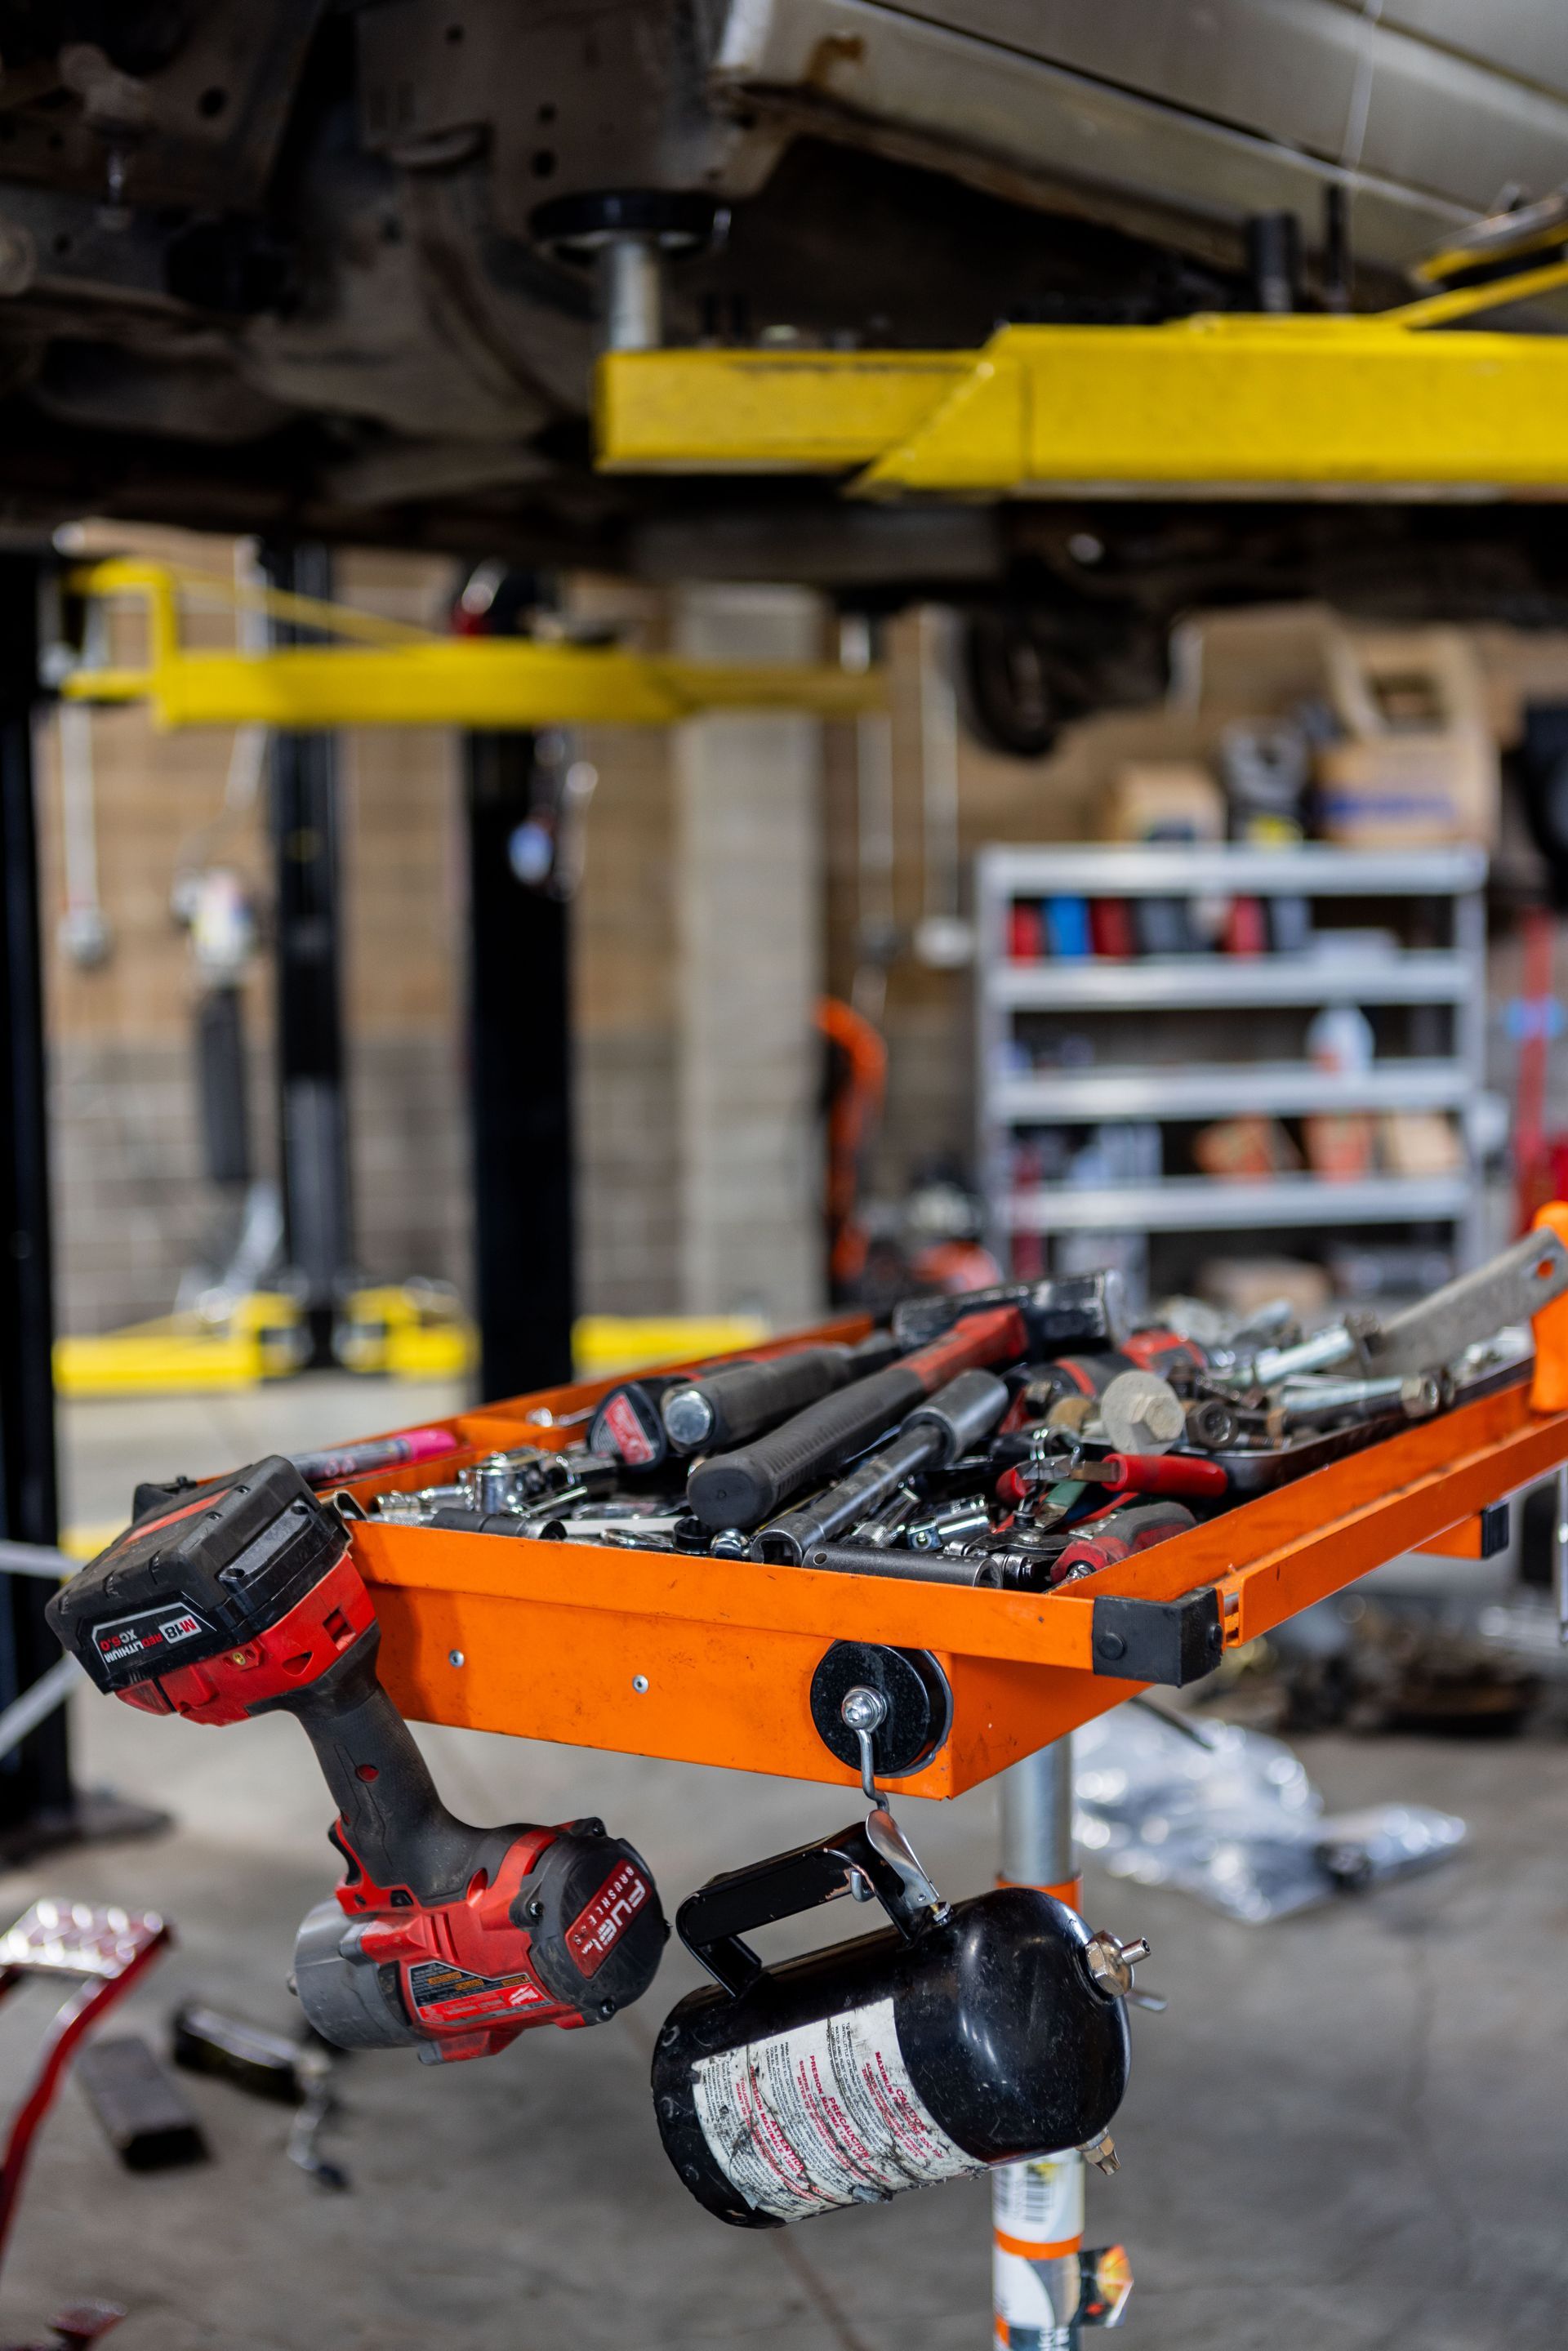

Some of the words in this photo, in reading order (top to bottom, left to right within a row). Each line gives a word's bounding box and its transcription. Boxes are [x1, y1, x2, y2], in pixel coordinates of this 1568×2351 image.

[103, 1632, 163, 1663] REDLITHIUM
[164, 1619, 197, 1640] M18
[581, 1878, 646, 1954] FUEL
[798, 2059, 810, 2091] SIEMPRE
[845, 2059, 851, 2068] OR
[846, 2021, 849, 2029] TO
[855, 2073, 863, 2090] HOLD
[722, 2074, 726, 2082] LA
[735, 2082, 743, 2104] AVANT
[741, 2106, 747, 2116] DE
[739, 2077, 752, 2114] TOUJOURS
[773, 2045, 777, 2053] EN
[776, 2067, 789, 2105] PULVERIZADOR
[786, 2105, 792, 2113] NO
[843, 2073, 855, 2098] CAUSING
[749, 2064, 763, 2110] PRESSION
[760, 2112, 783, 2153] MAXIMALE
[782, 2155, 798, 2172] 1380
[773, 2097, 783, 2115] MAYOR
[775, 2086, 790, 2118] SOLUCIONES
[785, 2077, 794, 2101] GATILLO
[791, 2100, 801, 2118] HASTA
[799, 2118, 807, 2130] QUE
[814, 2145, 826, 2159] POCO
[796, 2076, 807, 2099] ANTES
[804, 2100, 811, 2110] DE
[808, 2111, 826, 2138] RETIRAR
[809, 2055, 823, 2095] PRESION
[820, 2095, 840, 2128] MAXIMA
[838, 2131, 853, 2148] 1380
[845, 2095, 858, 2116] SHOULD
[857, 2116, 865, 2126] NOT
[861, 2068, 875, 2095] BEFORE
[873, 2097, 895, 2130] REMOVING
[893, 2131, 904, 2140] ANY
[902, 2141, 920, 2157] PARTS
[865, 2062, 878, 2089] ALWAYS
[875, 2091, 906, 2135] DEPRESSURIZE
[905, 2136, 928, 2157] SPRAYER
[875, 2050, 894, 2095] MAXIMUM
[891, 2096, 921, 2135] PRESSURE
[919, 2136, 933, 2148] 200
[931, 2149, 945, 2158] PSI
[895, 2088, 928, 2131] CAUTION
[769, 2118, 806, 2171] ATTENTION
